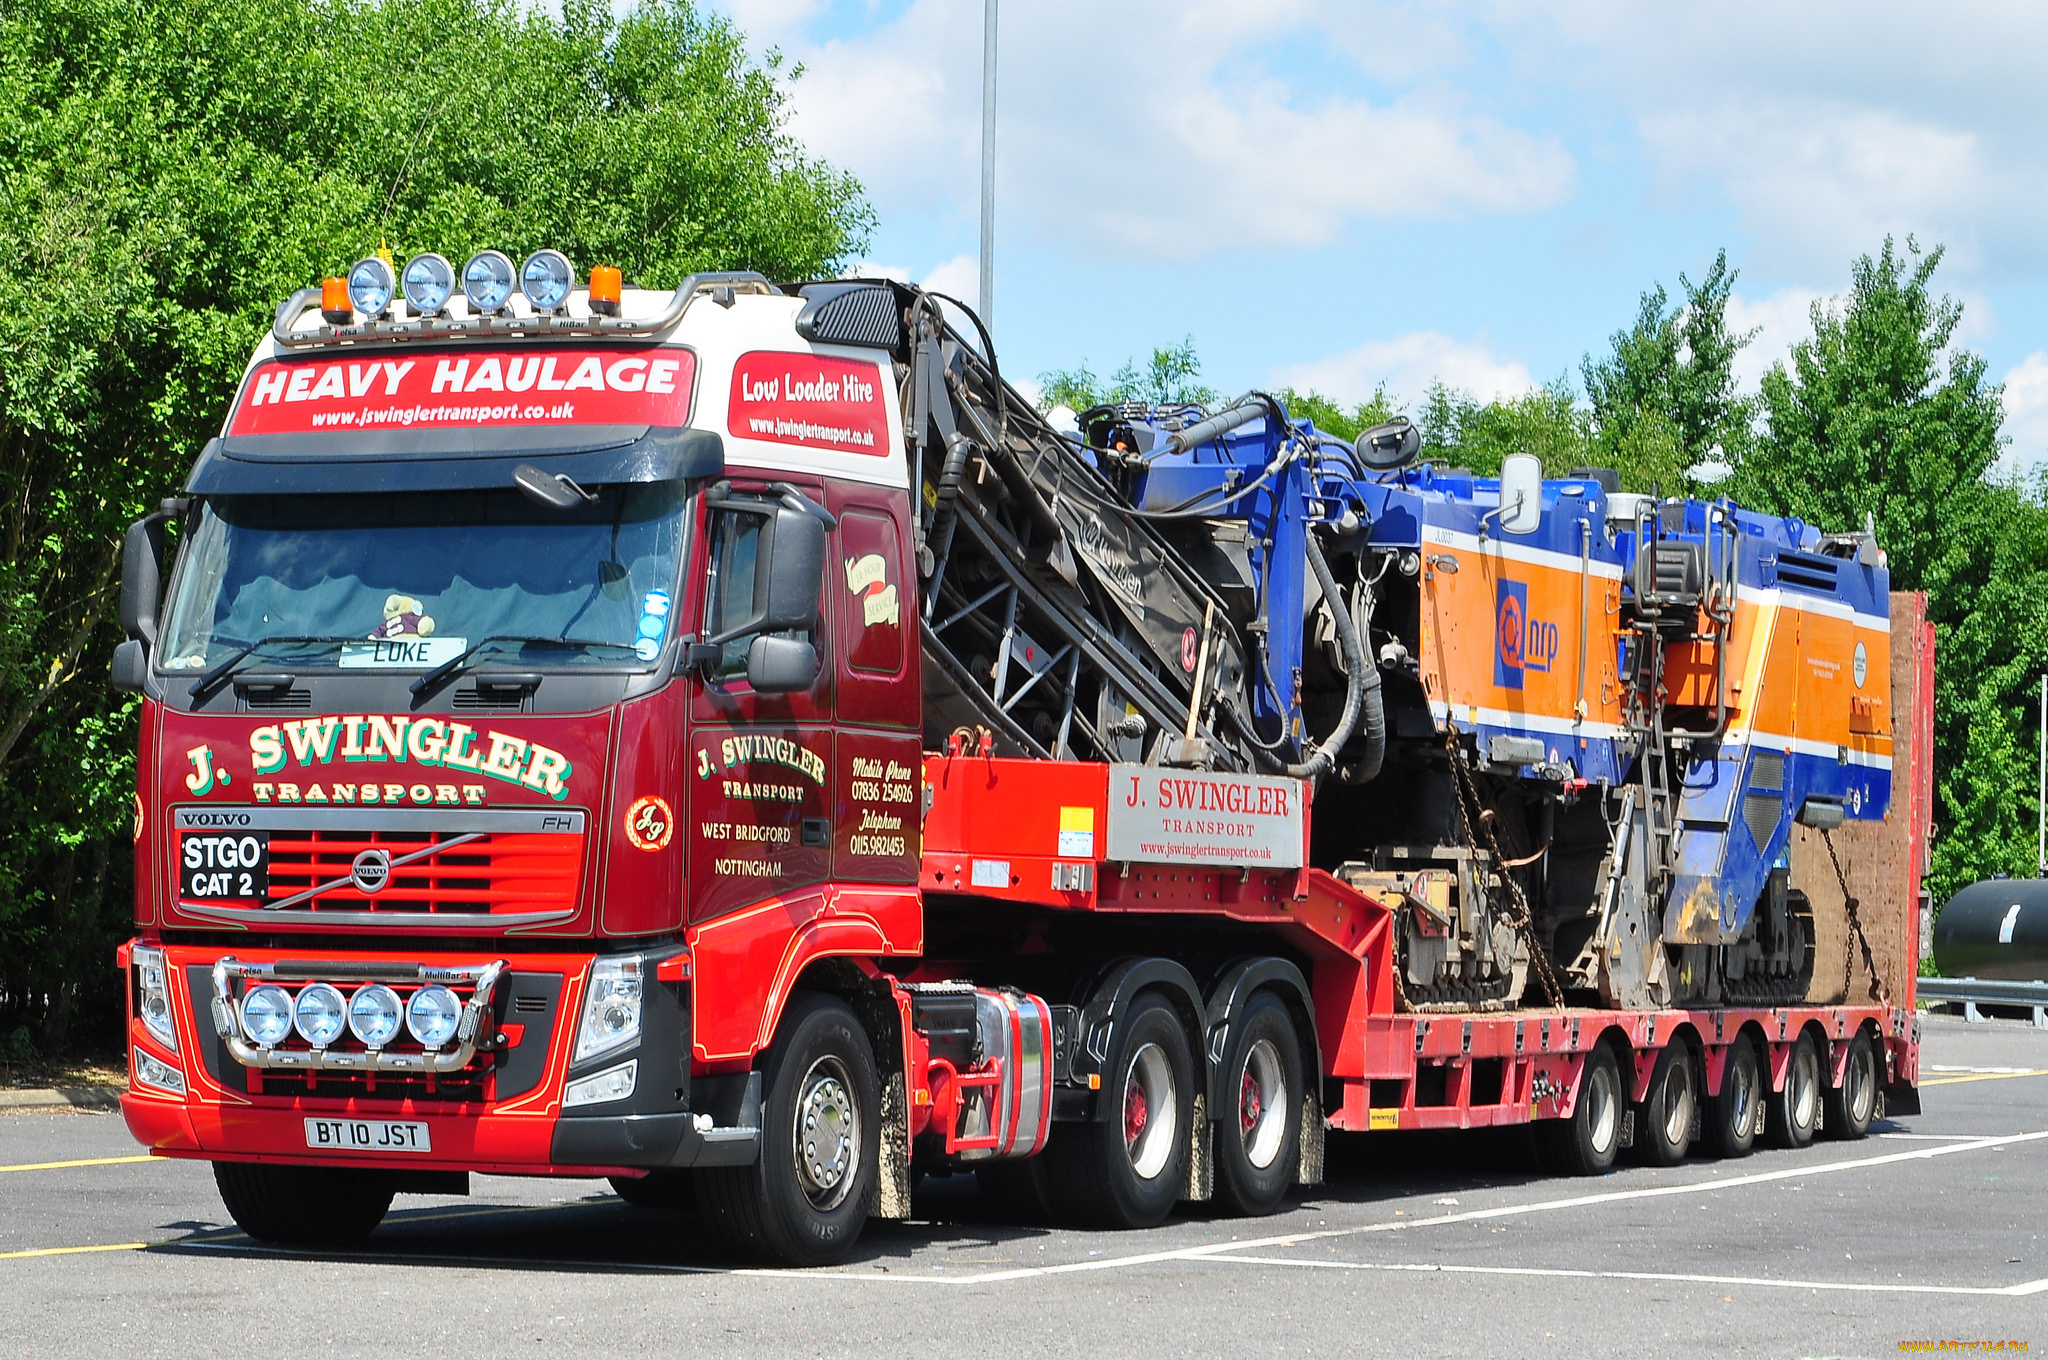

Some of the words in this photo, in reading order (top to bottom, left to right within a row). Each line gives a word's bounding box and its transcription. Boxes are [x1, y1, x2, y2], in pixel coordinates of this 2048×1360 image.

[251, 361, 416, 407] HEAVY
[431, 356, 680, 395] HAULAGE
[742, 372, 780, 402] Low
[784, 371, 840, 402] Loader
[842, 373, 874, 403] Hire
[312, 401, 575, 427] www.jswinglertransport.co.uk
[749, 417, 875, 447] www.jswinglertransport.co.uk
[868, 595, 893, 617] SERVICE
[373, 641, 432, 663] LUKE
[1529, 619, 1559, 673] nrp
[186, 744, 232, 796] J.
[250, 715, 573, 800] SWINGLER
[697, 748, 717, 780] J.
[721, 735, 827, 787] SWINGLER
[853, 756, 883, 780] Mobile
[885, 760, 912, 783] Phone
[252, 782, 488, 805] TRANSPORT
[722, 780, 805, 803] TRANSPORT
[852, 782, 881, 801] 07836
[882, 783, 914, 804] 254926
[1126, 776, 1146, 808] J.
[1159, 778, 1290, 817] SWINGLER
[181, 812, 252, 827] VOLVO
[541, 817, 573, 831] FH
[858, 808, 902, 834] Telephone
[1162, 818, 1256, 838] TRANSPORT
[702, 822, 732, 840] WEST
[735, 824, 791, 843] BRIDGFORD
[184, 836, 261, 869] STGO
[1140, 841, 1272, 861] www.jswinglertransport.co.uk
[354, 867, 387, 875] VOLVO
[714, 858, 783, 877] NOTTINGHAM
[191, 872, 232, 896] CAT
[239, 872, 254, 896] 2
[315, 1121, 343, 1144] BT
[377, 1124, 418, 1147] JST
